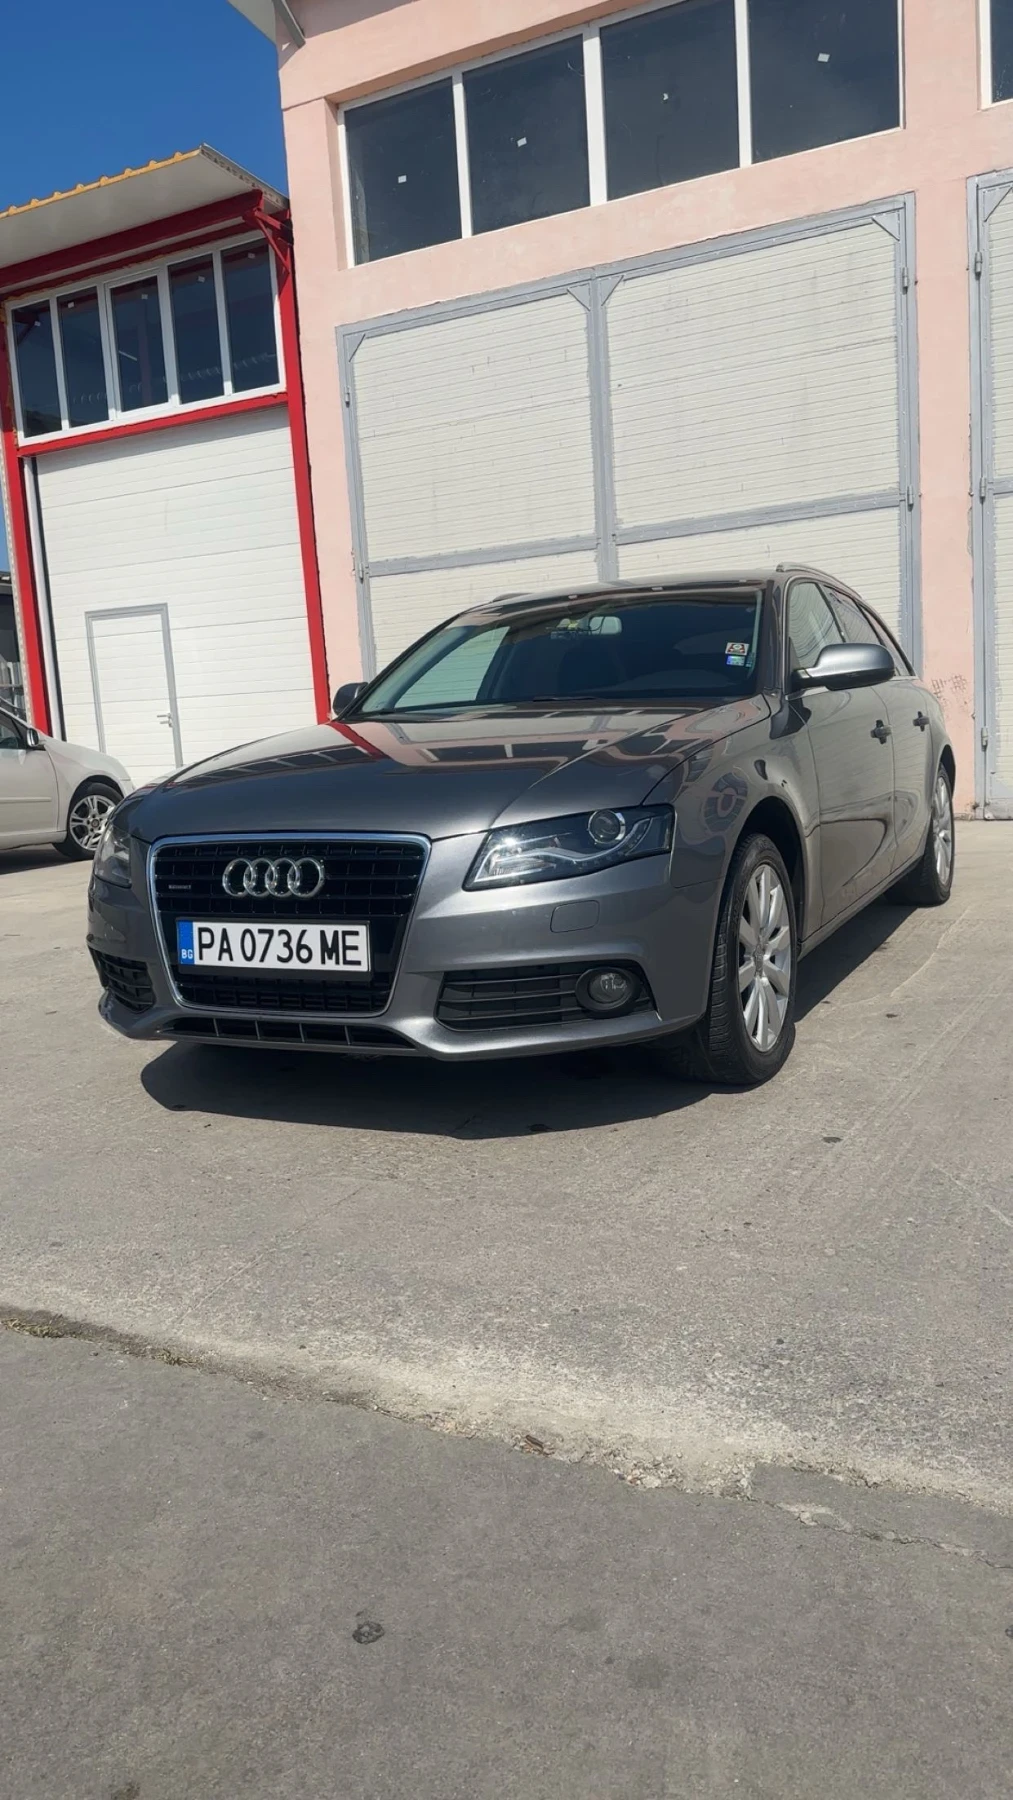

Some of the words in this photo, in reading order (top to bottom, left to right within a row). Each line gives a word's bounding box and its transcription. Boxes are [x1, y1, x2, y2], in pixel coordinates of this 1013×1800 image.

[181, 949, 193, 960] BG
[197, 926, 234, 962] PA
[240, 928, 313, 964] 0736
[320, 929, 362, 967] ME
